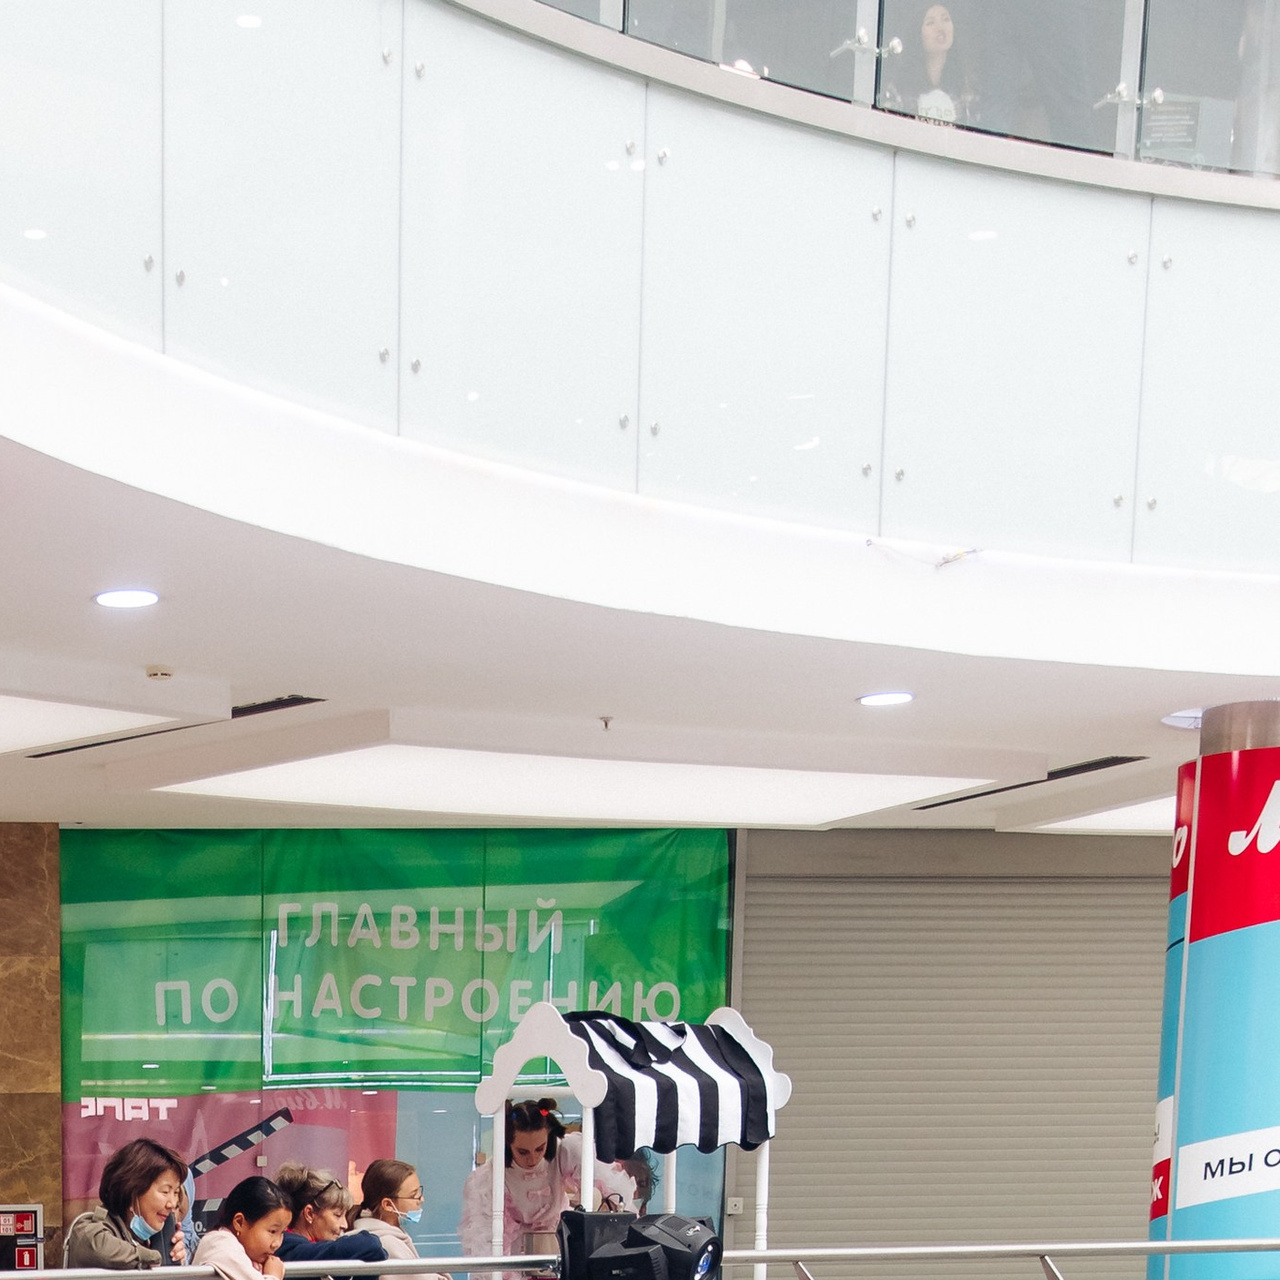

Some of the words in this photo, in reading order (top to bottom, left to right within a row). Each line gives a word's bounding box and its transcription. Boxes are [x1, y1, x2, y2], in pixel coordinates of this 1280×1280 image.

[278, 897, 564, 954] ГЛАВНЫЙ
[155, 979, 238, 1026] ПО
[274, 973, 681, 1023] НАСТРОЕНИЮ
[1203, 1153, 1253, 1180] МЫ
